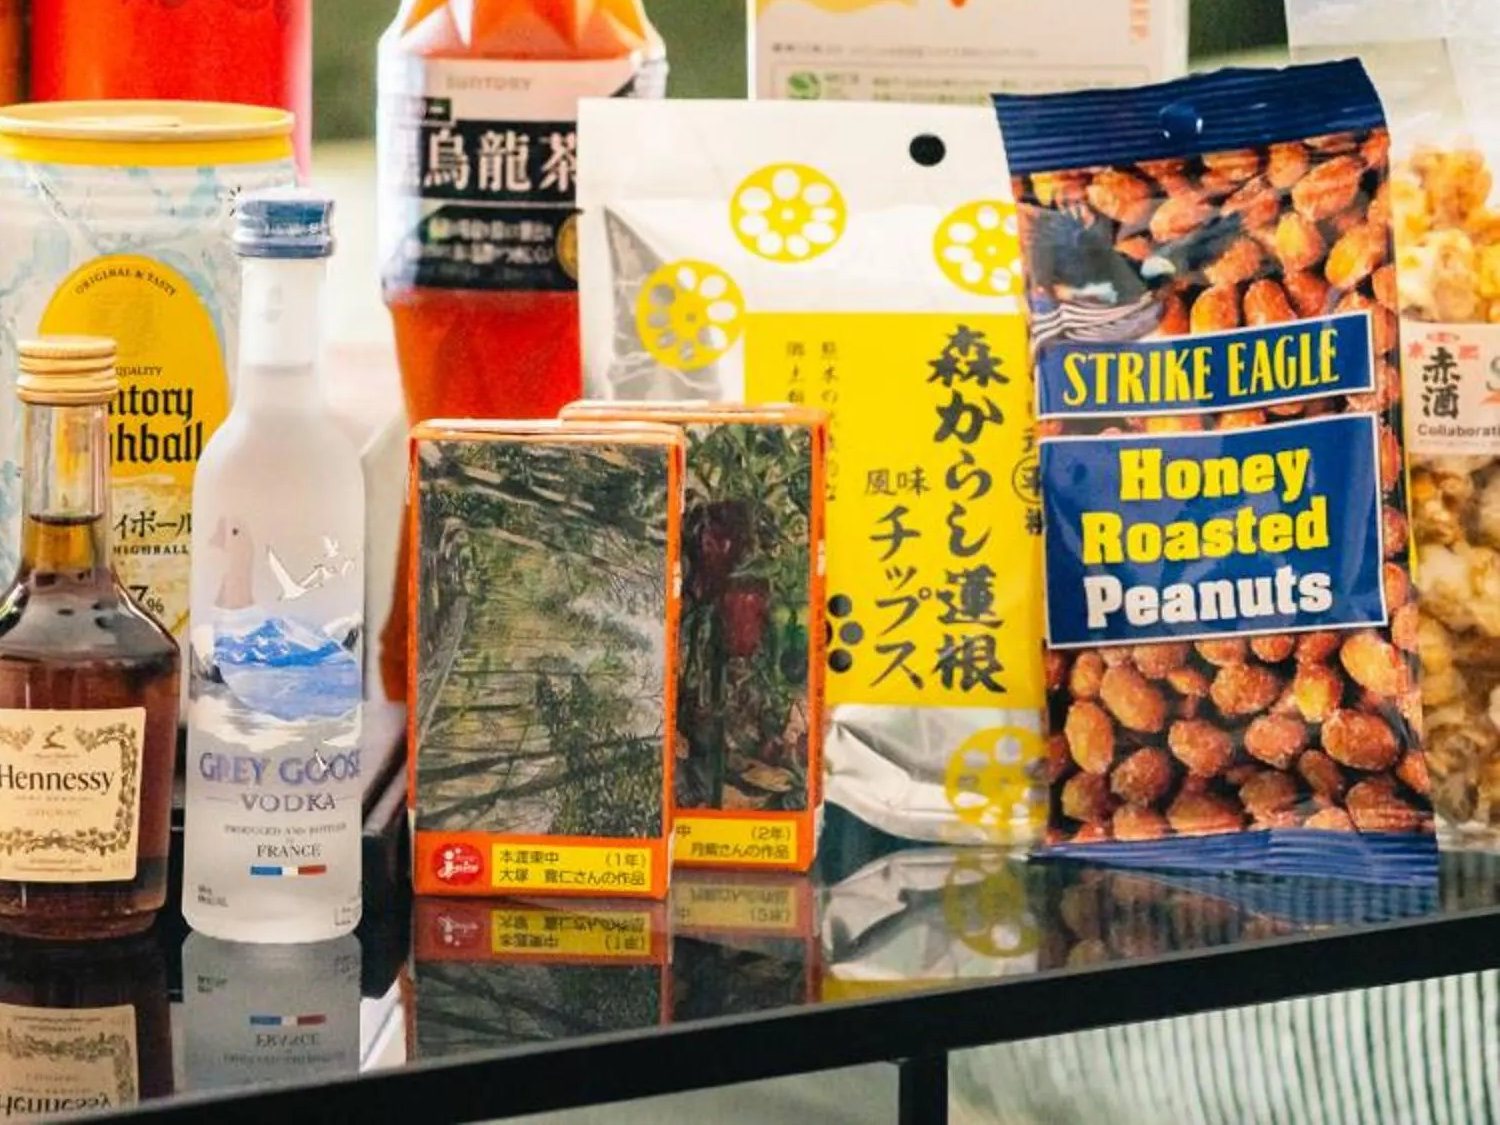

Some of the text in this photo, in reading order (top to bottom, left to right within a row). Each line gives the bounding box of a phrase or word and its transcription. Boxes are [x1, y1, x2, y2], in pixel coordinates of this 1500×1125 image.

[1063, 329, 1340, 406] STRIKE EAGLE
[1421, 346, 1462, 420] 赤酒
[106, 385, 194, 422] ntory
[109, 422, 203, 465] hball
[863, 467, 931, 497] 風味
[1119, 447, 1311, 503] Honey
[112, 509, 193, 539] イボール
[1081, 496, 1330, 565] Roasted
[869, 505, 932, 691] チップス
[1083, 565, 1334, 630] Peanuts
[200, 751, 271, 786] GREY
[241, 793, 337, 813] VODKA
[257, 843, 322, 858] FRANCE
